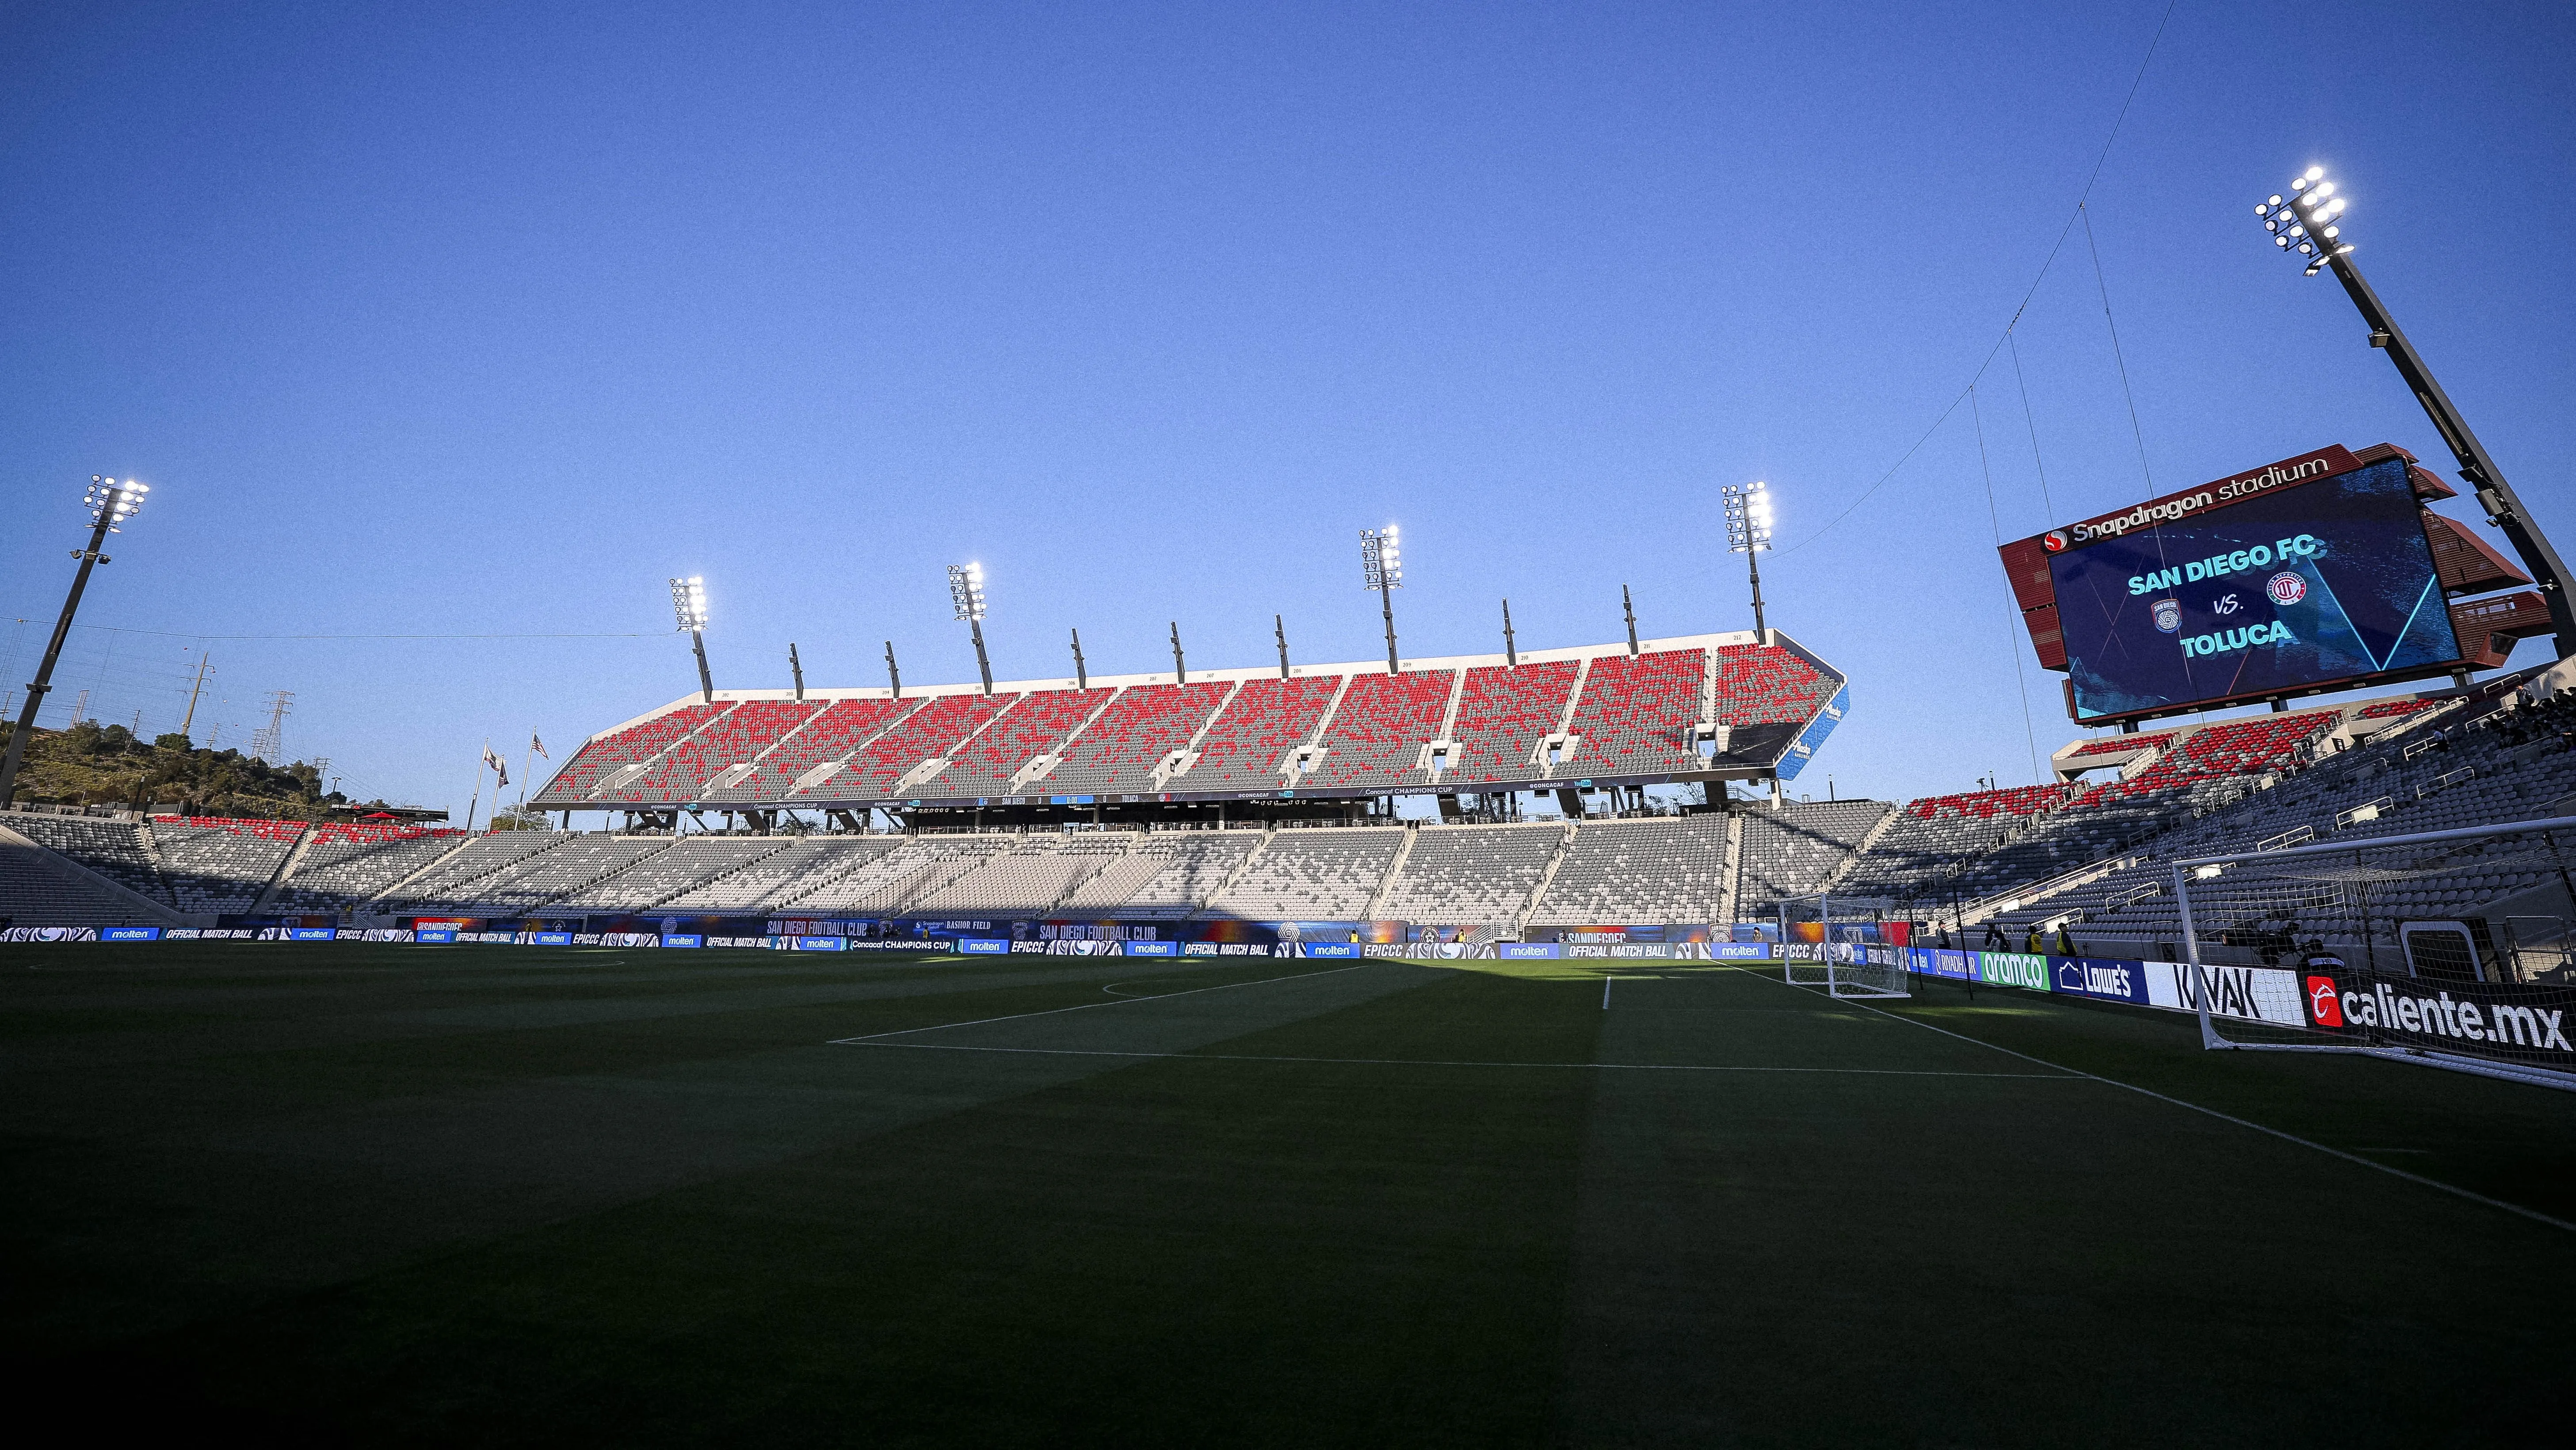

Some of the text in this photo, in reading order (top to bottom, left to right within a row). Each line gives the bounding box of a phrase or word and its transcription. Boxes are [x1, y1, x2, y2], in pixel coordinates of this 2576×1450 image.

[2073, 458, 2329, 542] Snapdragon stadium
[2129, 534, 2317, 596] SAN DIEGO FC
[2179, 620, 2293, 658] TOLUCA
[1826, 703, 1841, 717] Alaska
[1794, 740, 1811, 754] Alaska
[1574, 779, 1591, 787] YouTube
[767, 921, 867, 936] SAN DIEGO FOOTBALL CLUB
[1040, 925, 1156, 941] SAN DIEGO FOOTBALL CLUB
[111, 930, 148, 939] molten
[166, 930, 252, 939] OFFICIAL MATCH BALL
[336, 930, 362, 939] EPICCC
[455, 932, 511, 942] OFFICIAL MATCH BALL
[541, 934, 565, 942] molten
[573, 935, 600, 944] EPICCC
[668, 936, 695, 945] molten
[707, 936, 772, 947] OFFICIAL MATCH BALL
[807, 939, 834, 948] molten
[853, 940, 950, 950] Concacaf CHAMPIONS CUP
[970, 942, 999, 951] molten
[1011, 942, 1045, 953] EPICCC
[1135, 944, 1168, 953] molten
[1185, 944, 1268, 955] OFFICIAL MATCH BALL
[1315, 946, 1350, 955] molten
[1364, 944, 1403, 957] EPICCC
[1510, 946, 1549, 956] molten
[1569, 946, 1667, 957] OFFICIAL MATCH BALL
[1722, 946, 1759, 956] molten
[1912, 952, 1928, 968] mlten
[1941, 954, 1976, 974] RIYADH IR
[1985, 953, 2043, 988] aramco
[2083, 962, 2131, 997] LOWE'S
[2343, 983, 2574, 1052] caliente.mx
